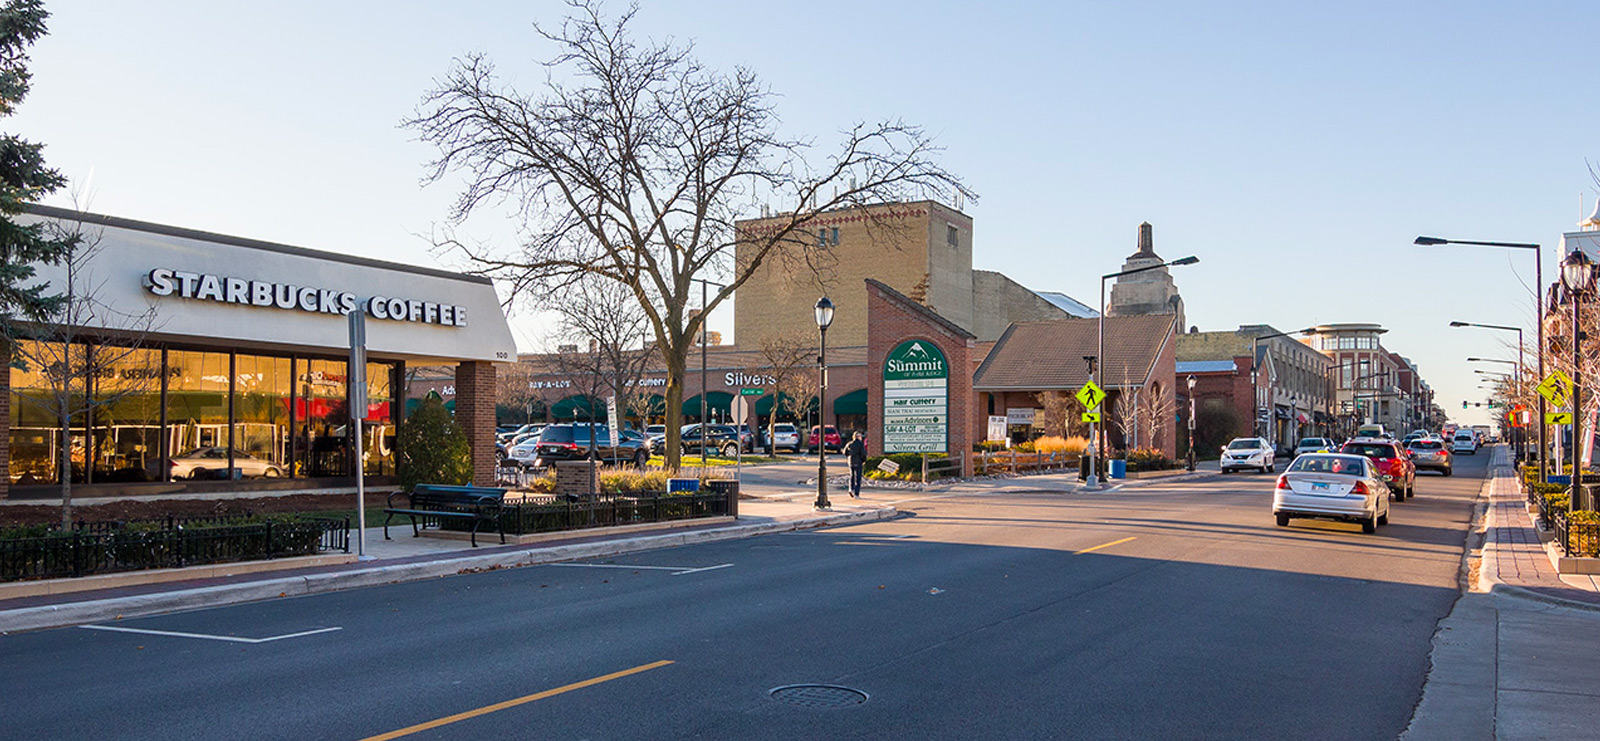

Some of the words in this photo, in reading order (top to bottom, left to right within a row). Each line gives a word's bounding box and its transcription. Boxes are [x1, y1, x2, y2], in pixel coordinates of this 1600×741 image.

[149, 267, 356, 317] STARBUCKS
[368, 296, 468, 327] COFFEE
[888, 357, 943, 372] Summit
[725, 372, 777, 386] Silvers
